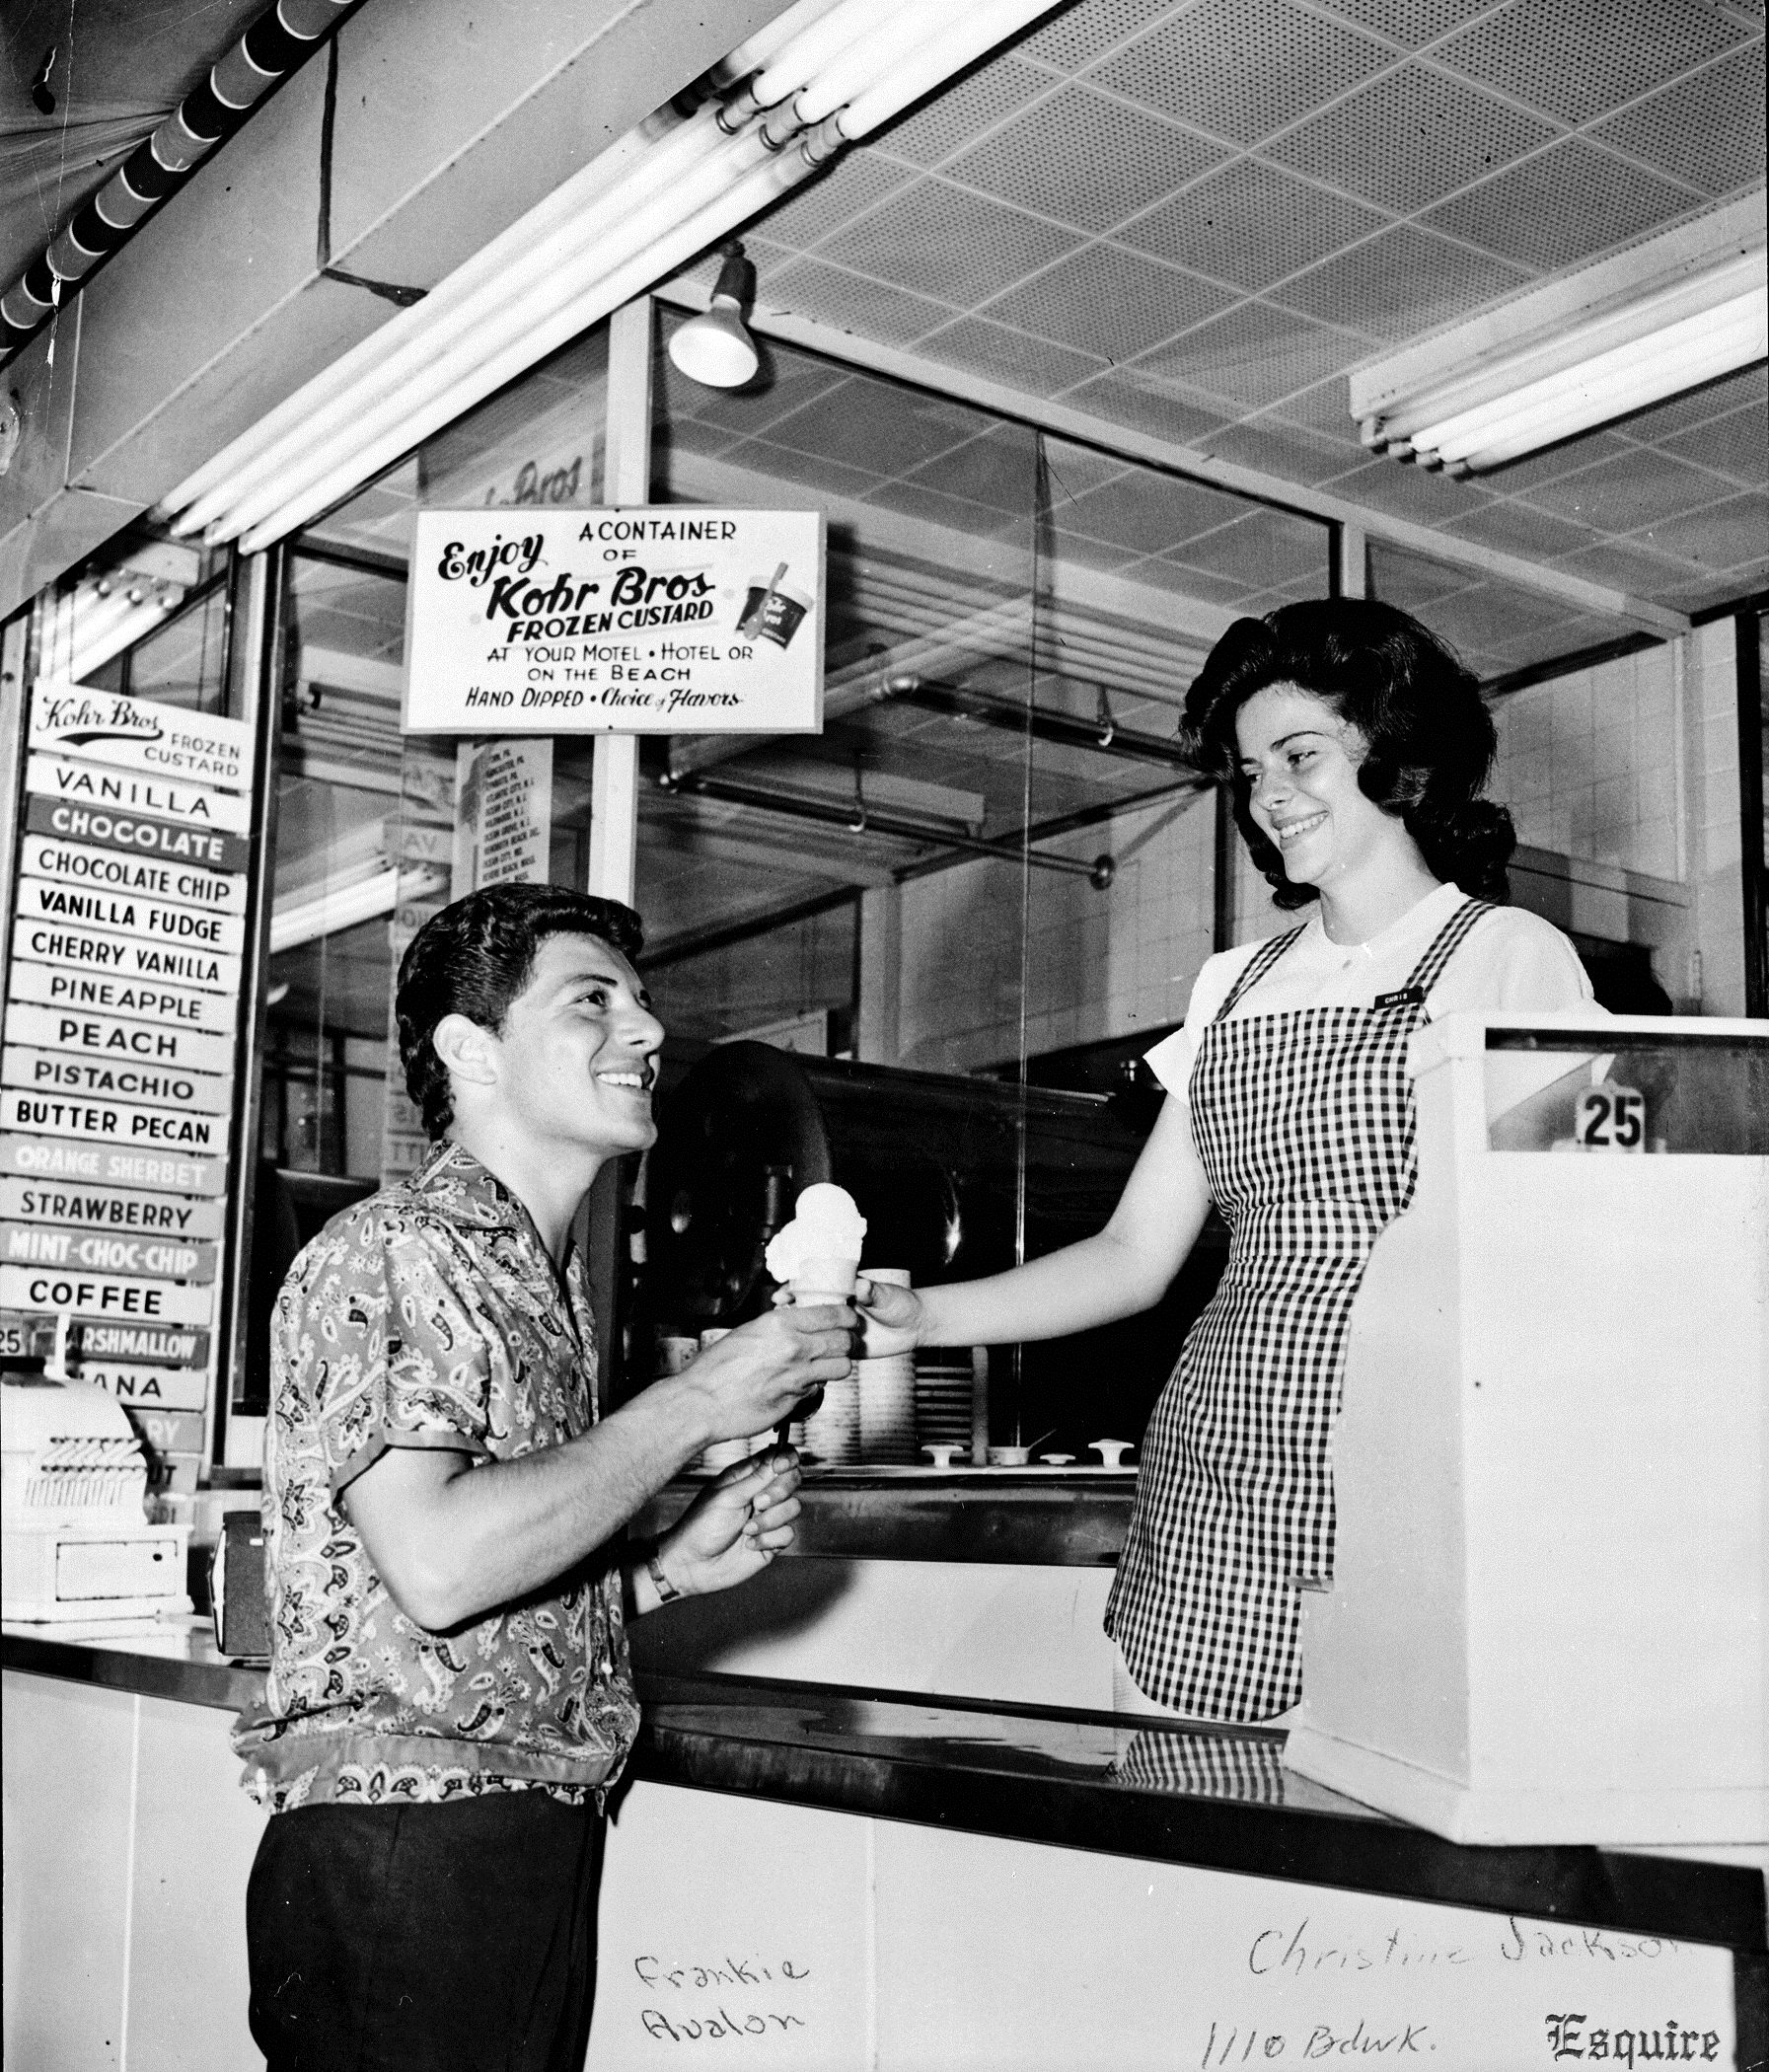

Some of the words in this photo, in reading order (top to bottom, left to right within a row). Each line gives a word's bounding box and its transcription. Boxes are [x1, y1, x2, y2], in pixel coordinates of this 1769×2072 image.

[578, 523, 594, 542] A
[598, 520, 737, 542] CONTAINER
[438, 534, 549, 587] Enjoy
[602, 548, 637, 561] OF
[486, 572, 600, 621] Kohr
[610, 565, 716, 606] Bros
[506, 612, 613, 643] FROZEN
[617, 600, 714, 630] CUSTARD
[486, 645, 512, 662] AT
[525, 645, 576, 662] YOUR
[582, 644, 642, 662] MOTEL
[661, 642, 721, 660] HOTEL
[728, 645, 754, 660] OR
[527, 667, 554, 681] ON
[564, 667, 598, 681] THE
[611, 664, 691, 681] BEACH
[36, 696, 106, 732] Kohr
[466, 687, 514, 707] HAND
[521, 687, 584, 707] DIPPED
[601, 687, 655, 707] Choice
[669, 688, 744, 712] Flavors
[144, 746, 239, 777] CUSTARD
[171, 732, 241, 759] FROZEN
[56, 768, 210, 818] VANILLA
[51, 807, 224, 861] CHOCOLATE
[38, 849, 170, 893] CHOCOLATE
[178, 875, 230, 902] CHIP
[40, 889, 135, 925] VANILLA
[149, 910, 222, 942] FUDGE
[32, 931, 125, 966] CHERRY
[137, 949, 219, 982] VANILLA
[50, 976, 202, 1020] PINEAPPLE
[1384, 993, 1408, 1004] CHRIS
[58, 1019, 177, 1058] PEACH
[35, 1061, 194, 1100] PISTACHIO
[17, 1100, 117, 1133] BUTTER
[131, 1115, 210, 1144] PECAN
[1584, 1093, 1642, 1147] 25
[15, 1146, 101, 1175] ORANGE
[108, 1154, 206, 1187] SHERBET
[21, 1191, 192, 1228] STRAWBERRY
[8, 1230, 197, 1274] MINT-CHOC-CHIP
[30, 1280, 162, 1315] COFFEE
[634, 1953, 810, 1989] Frankie
[641, 2006, 806, 2041] Avalon
[1201, 2022, 1286, 2070] 1110
